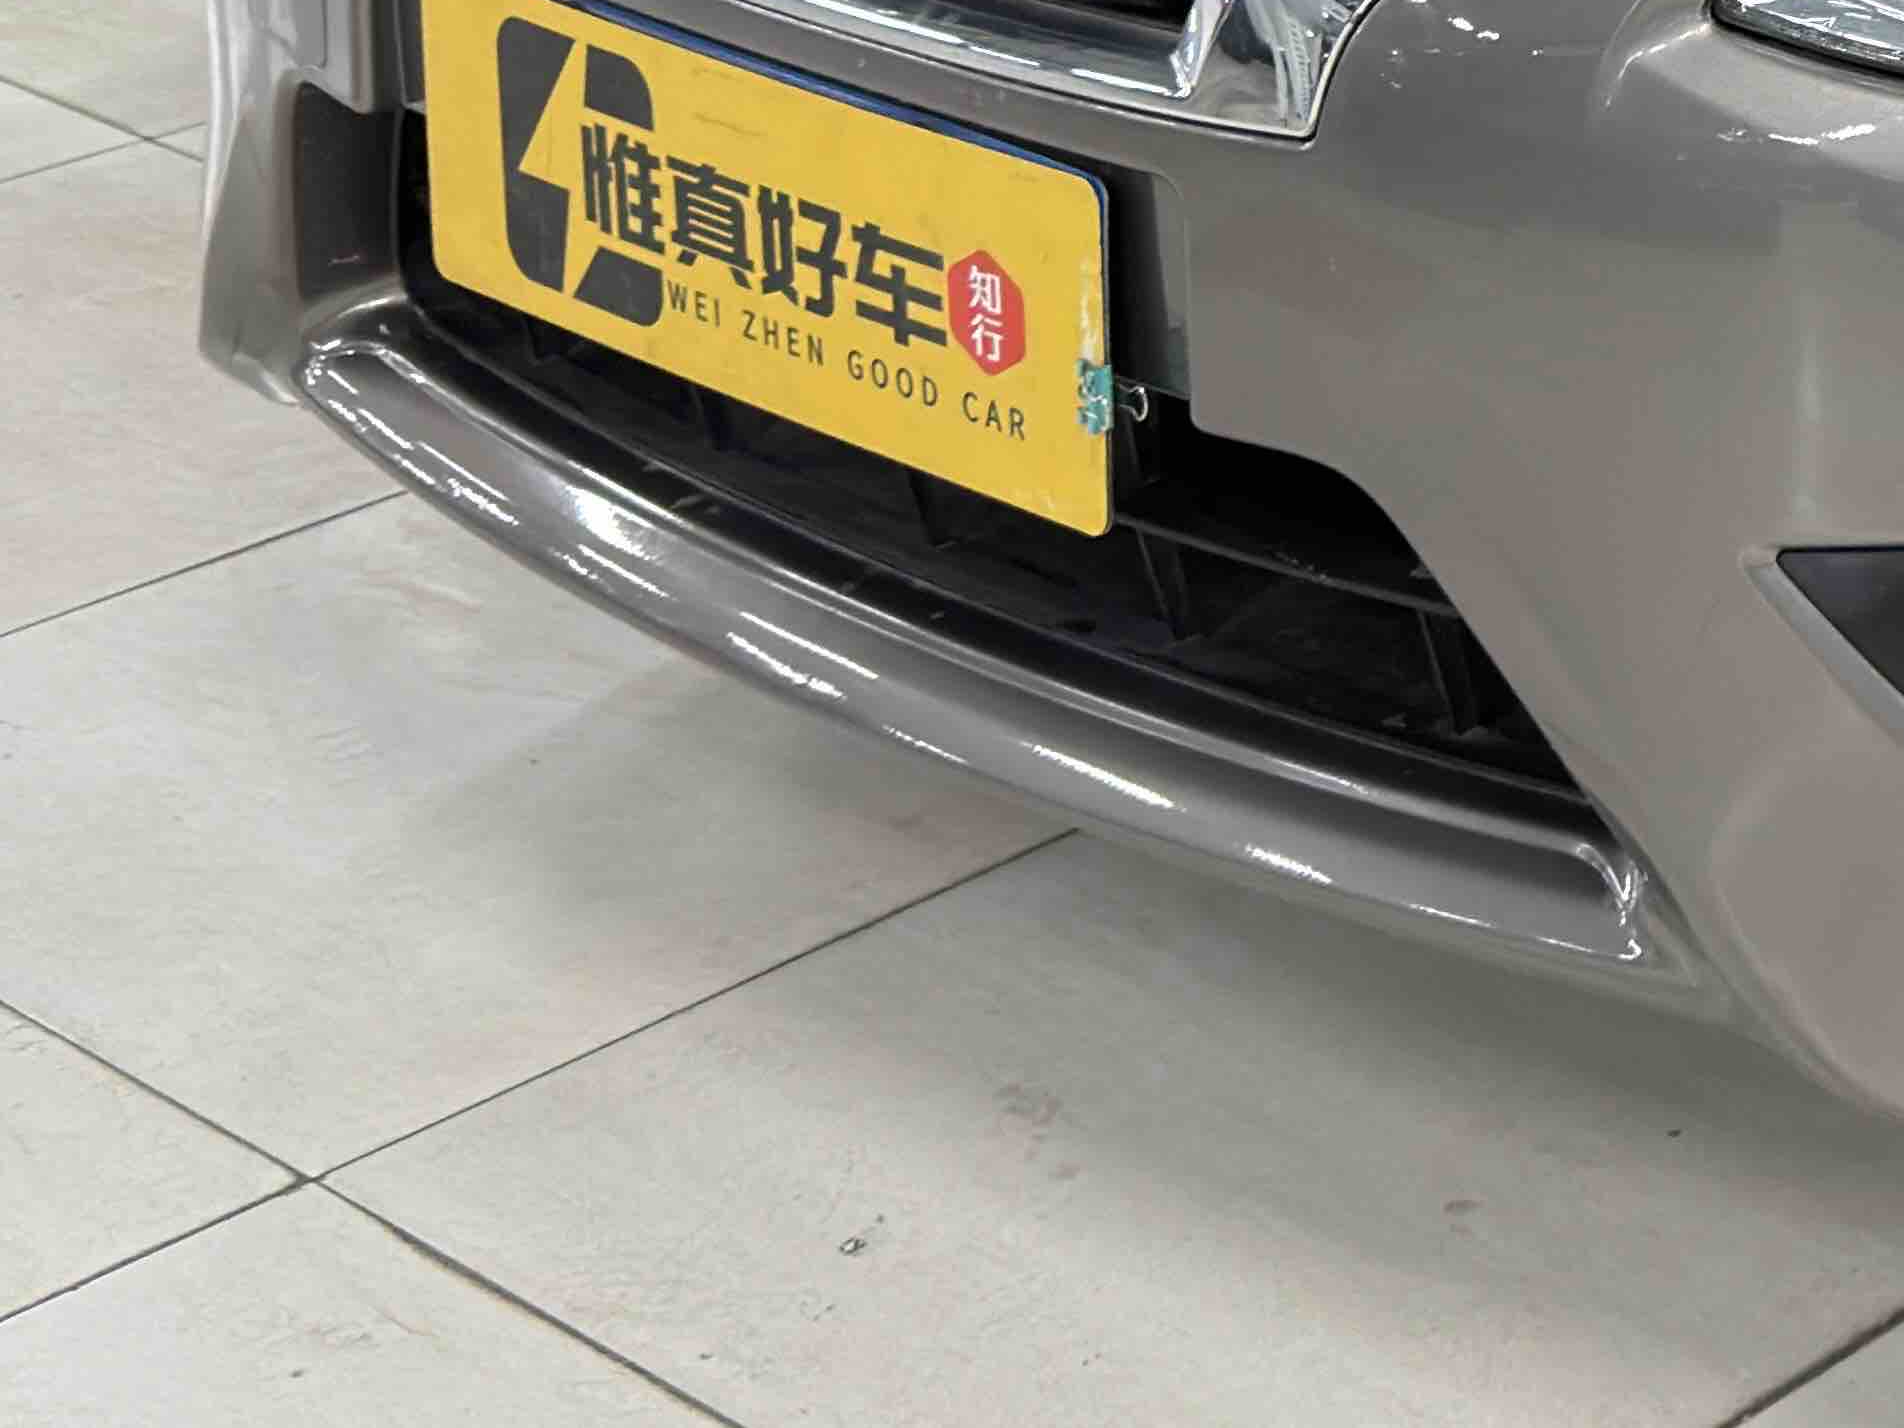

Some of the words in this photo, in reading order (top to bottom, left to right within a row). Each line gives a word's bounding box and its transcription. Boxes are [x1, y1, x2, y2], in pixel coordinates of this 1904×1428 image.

[581, 122, 948, 348] 惟真好车
[967, 264, 1004, 363] 知行
[666, 279, 721, 327] WEI
[742, 309, 824, 366] ZHEN
[846, 349, 939, 407] GOOD
[962, 391, 1025, 441] CAR
